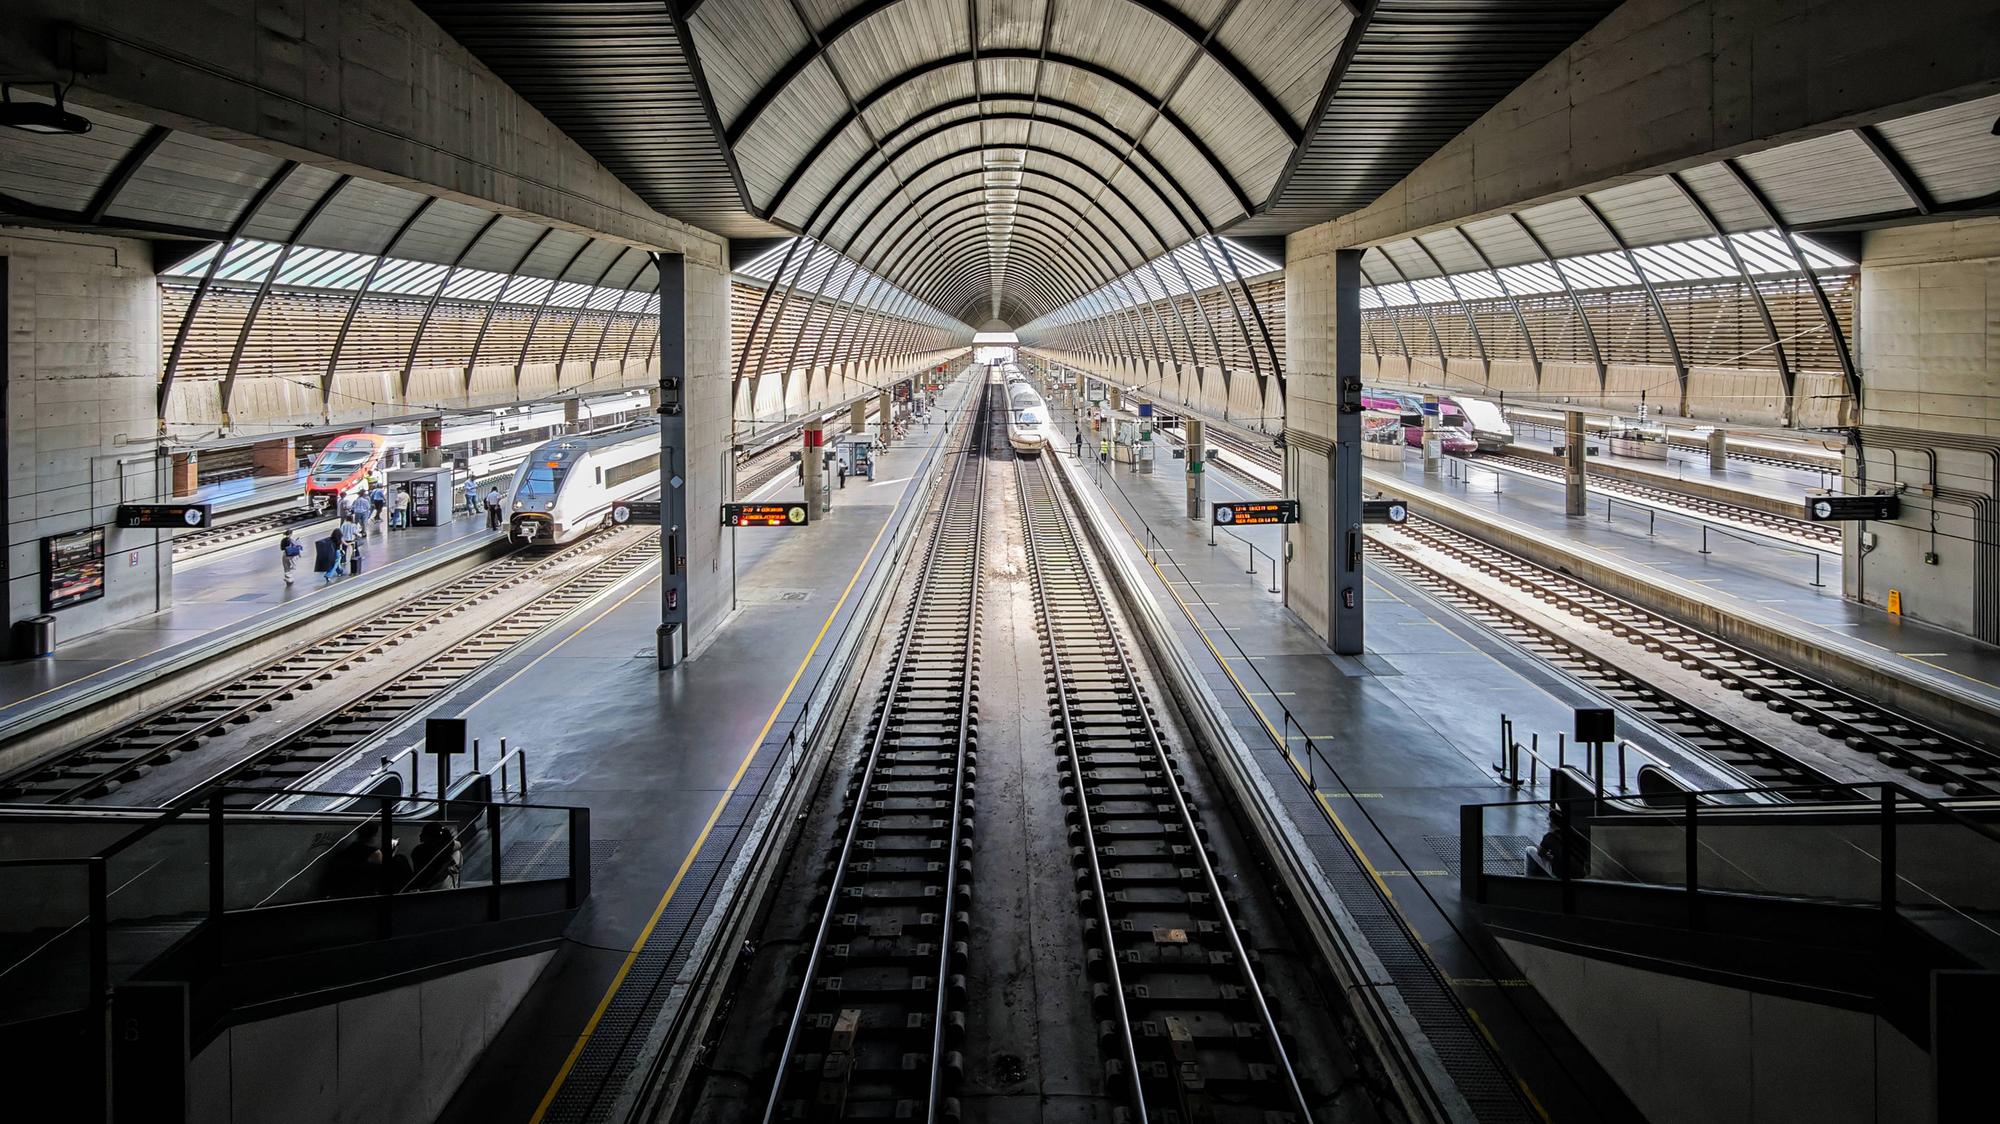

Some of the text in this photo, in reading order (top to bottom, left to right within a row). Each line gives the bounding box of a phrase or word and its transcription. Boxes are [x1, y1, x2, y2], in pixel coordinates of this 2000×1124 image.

[1281, 511, 1290, 523] 7
[1881, 508, 1888, 518] 5
[129, 517, 140, 526] 10
[731, 515, 739, 525] 8
